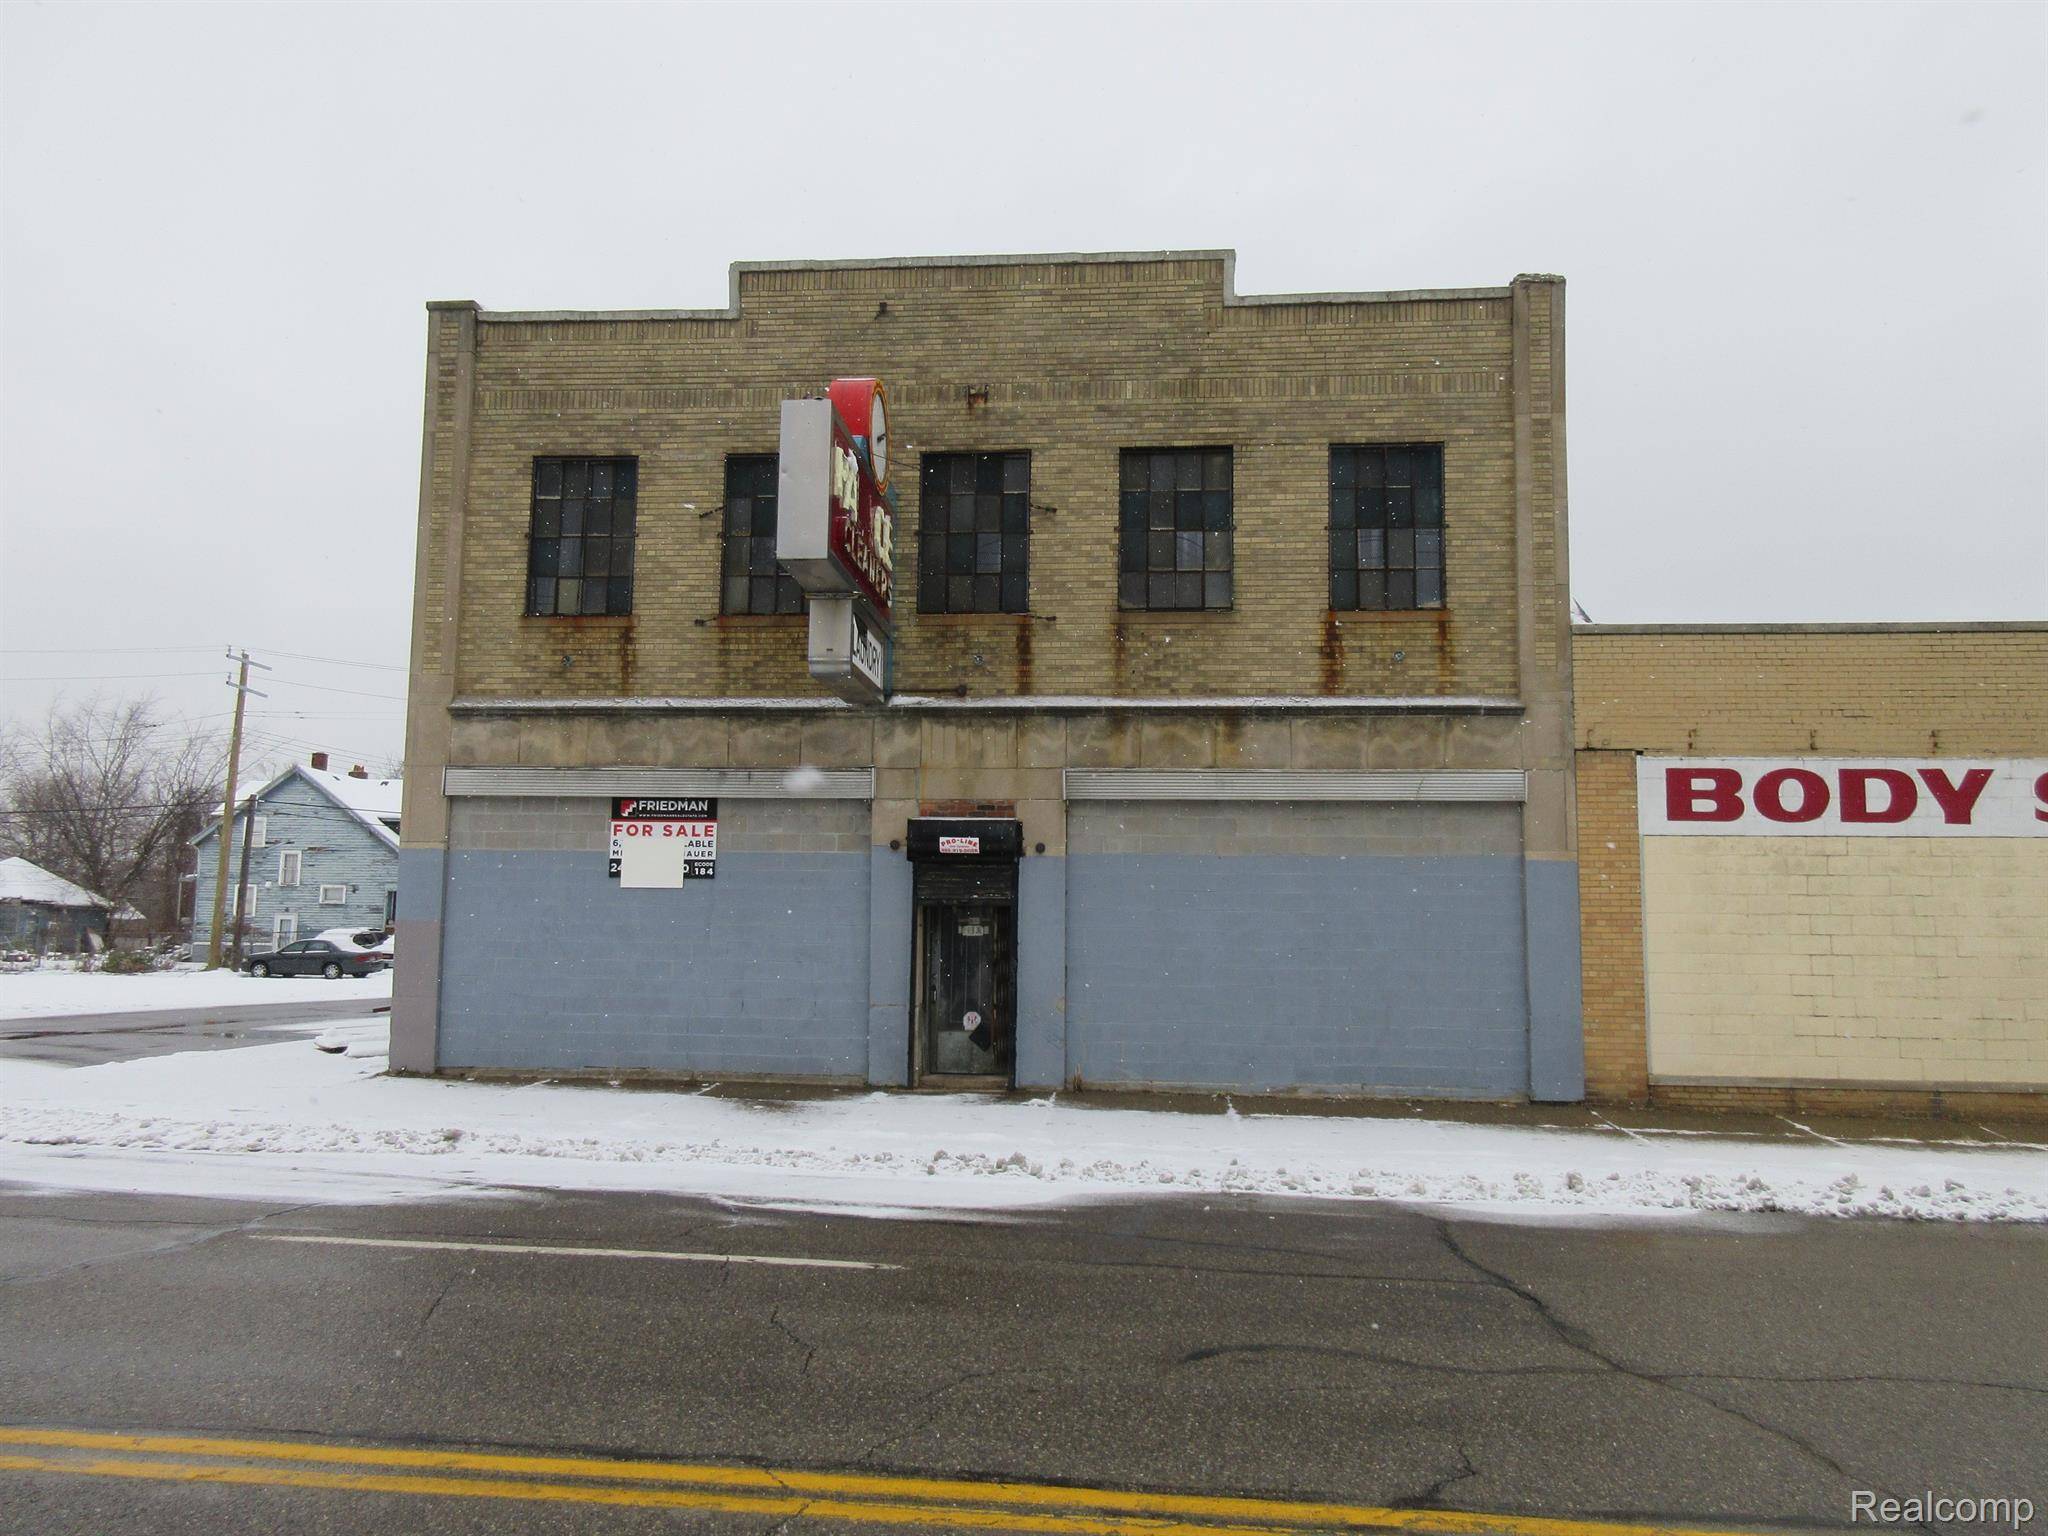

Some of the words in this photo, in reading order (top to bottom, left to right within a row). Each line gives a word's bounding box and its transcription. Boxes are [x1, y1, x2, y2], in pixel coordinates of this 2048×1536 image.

[1665, 768, 1994, 824] BODY
[639, 801, 708, 811] FRIEDMAN
[613, 824, 653, 837] FOR
[663, 824, 714, 837] SALE
